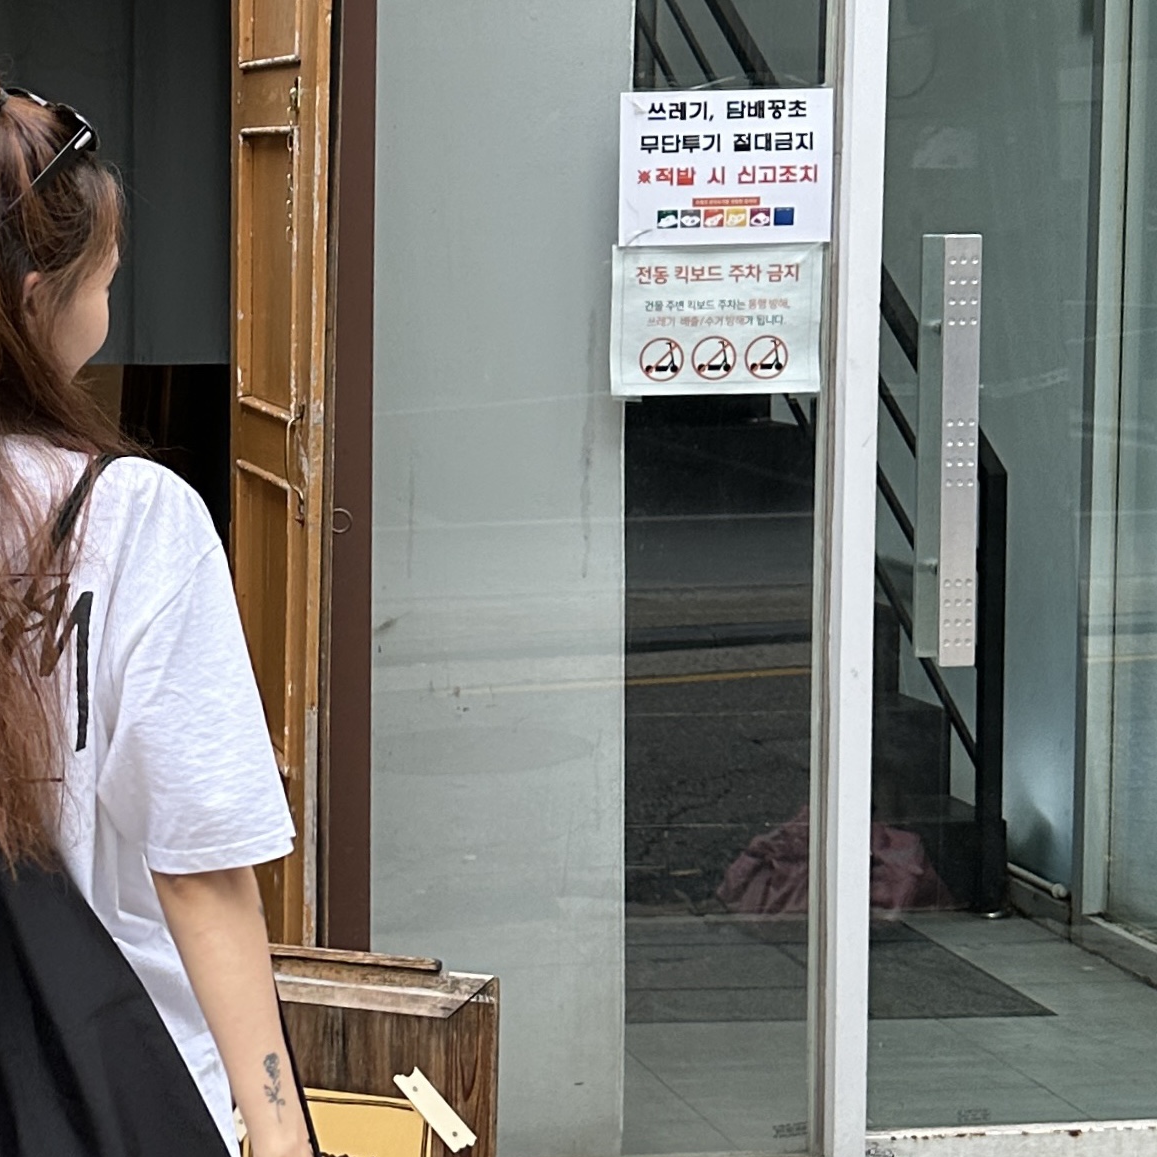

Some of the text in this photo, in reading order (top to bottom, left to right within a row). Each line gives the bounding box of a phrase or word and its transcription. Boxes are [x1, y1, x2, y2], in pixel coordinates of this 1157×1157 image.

[647, 99, 807, 121] 쓰레기, 담배꽁초
[639, 131, 814, 154] 무단투기 절대금지
[706, 165, 726, 185] 시
[737, 164, 818, 185] 신고조치
[635, 262, 801, 285] 전동 킥보드 주차 금지
